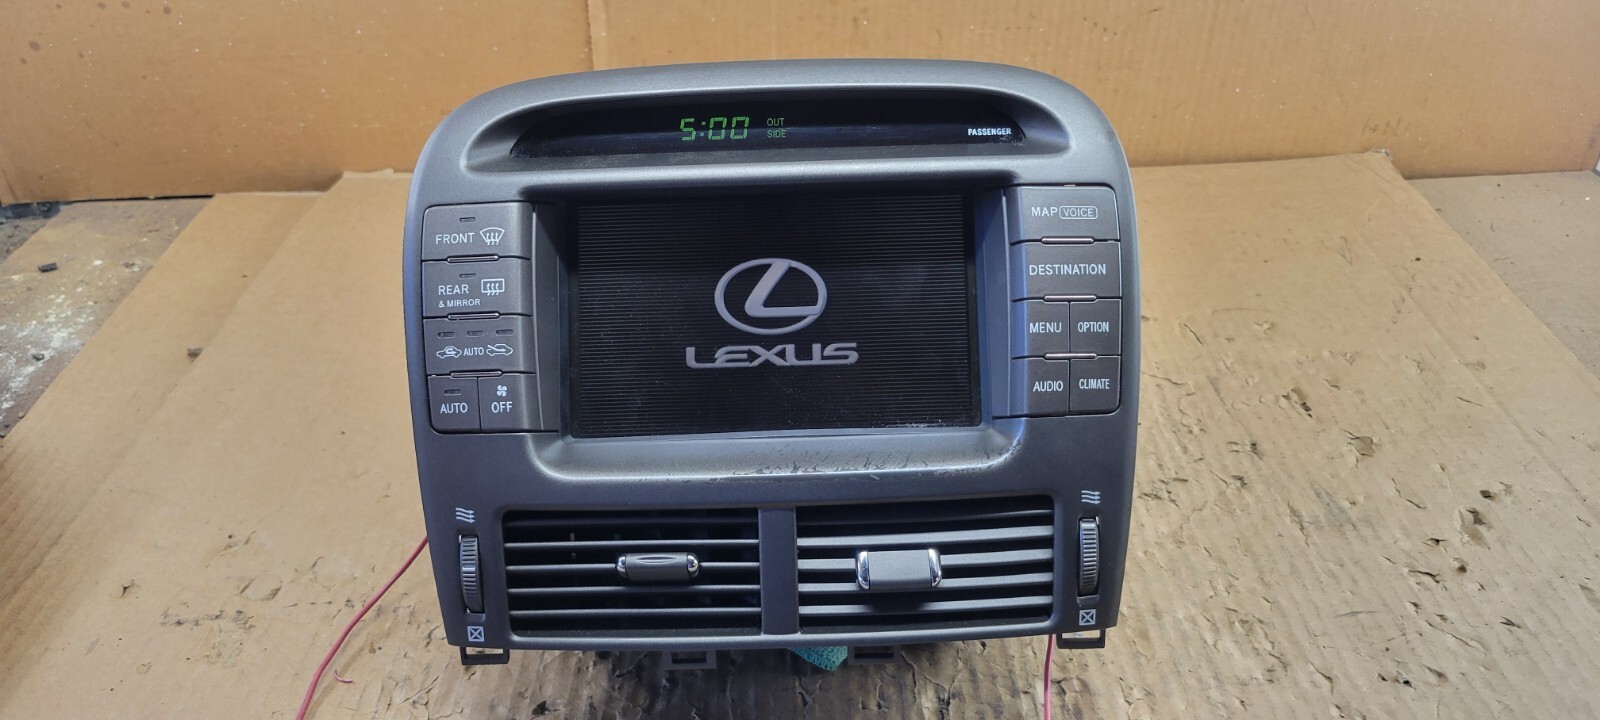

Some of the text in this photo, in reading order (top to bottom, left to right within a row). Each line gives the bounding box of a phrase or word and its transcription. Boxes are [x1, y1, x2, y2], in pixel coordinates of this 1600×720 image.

[766, 117, 785, 126] OUT
[679, 116, 750, 141] 5:00
[766, 129, 787, 138] SIDE
[967, 127, 1012, 136] PASSENGER
[1031, 206, 1094, 217] MAP VOICE
[435, 232, 476, 245] FRONT
[1029, 263, 1107, 276] DESTINATION
[438, 284, 470, 295] REAR
[438, 298, 481, 308] & MIRROR
[1029, 322, 1062, 334] MENU
[1077, 321, 1110, 333] OPTION
[463, 347, 485, 356] AUTO
[685, 342, 859, 369] LEXUS
[1033, 380, 1064, 392] AUDIO
[1078, 378, 1110, 390] CLIMATE
[440, 402, 468, 414] AUTO
[491, 401, 513, 413] OFF
